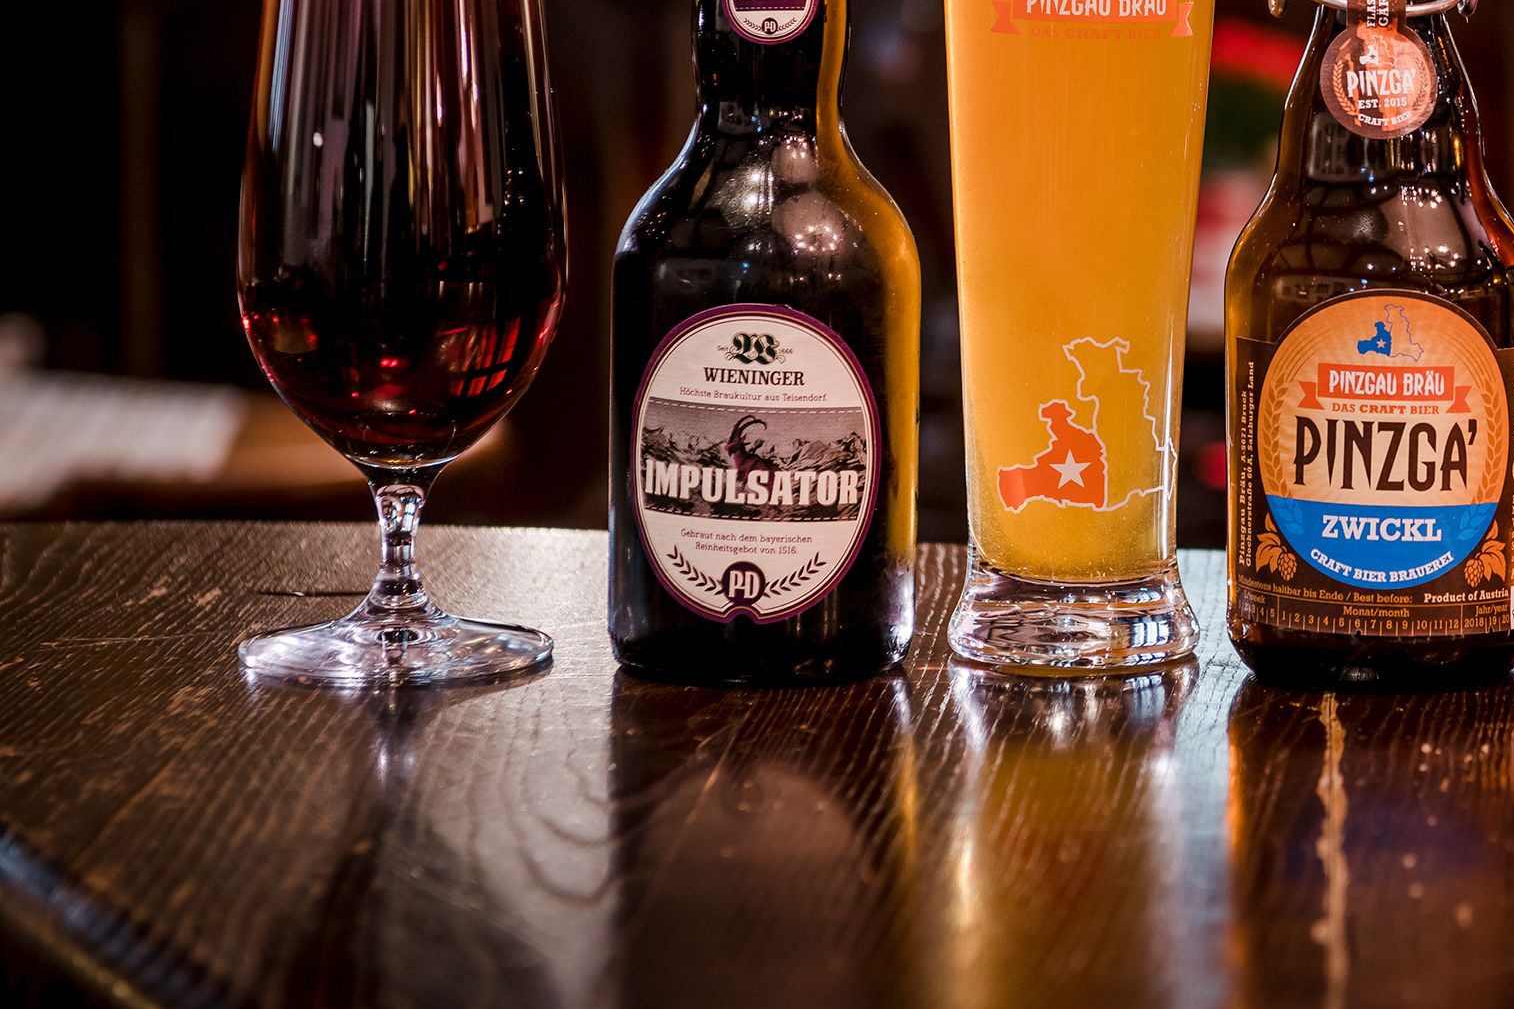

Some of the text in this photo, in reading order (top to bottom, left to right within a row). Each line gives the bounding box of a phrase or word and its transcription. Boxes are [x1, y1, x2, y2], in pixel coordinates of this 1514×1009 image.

[1030, 27, 1162, 40] DAS CRAFT BIER
[1358, 97, 1407, 109] EST. 2015
[1358, 111, 1412, 125] CRAFT BIER
[703, 367, 805, 387] WIENINGER
[1329, 370, 1444, 396] PINZGAU BRÄU
[680, 387, 712, 398] Höchste
[714, 390, 761, 401] Braukultur
[764, 393, 780, 401] aus
[1332, 403, 1440, 415] DAS CRAFT BIER
[645, 459, 858, 506] IMPULSATOR
[1322, 515, 1442, 541] ZWICKL
[681, 528, 812, 544] Gebraut nach dem bayerischen
[695, 541, 757, 555] Reinheitsgebot
[1310, 548, 1454, 582] CRAFT BIER BRAUEREI
[1273, 583, 1302, 596] haltbar
[1304, 588, 1317, 599] bis
[1319, 590, 1344, 600] Ende
[1354, 592, 1374, 602] Best
[1377, 593, 1412, 603] before:
[1424, 588, 1509, 603] Product of Austria
[1343, 606, 1410, 617] Monat/month
[1475, 604, 1508, 617] Jahr/year
[1282, 611, 1459, 629] 1 2 3 4 5 6 7 8 9 10 11 12
[1464, 618, 1484, 628] 2018
